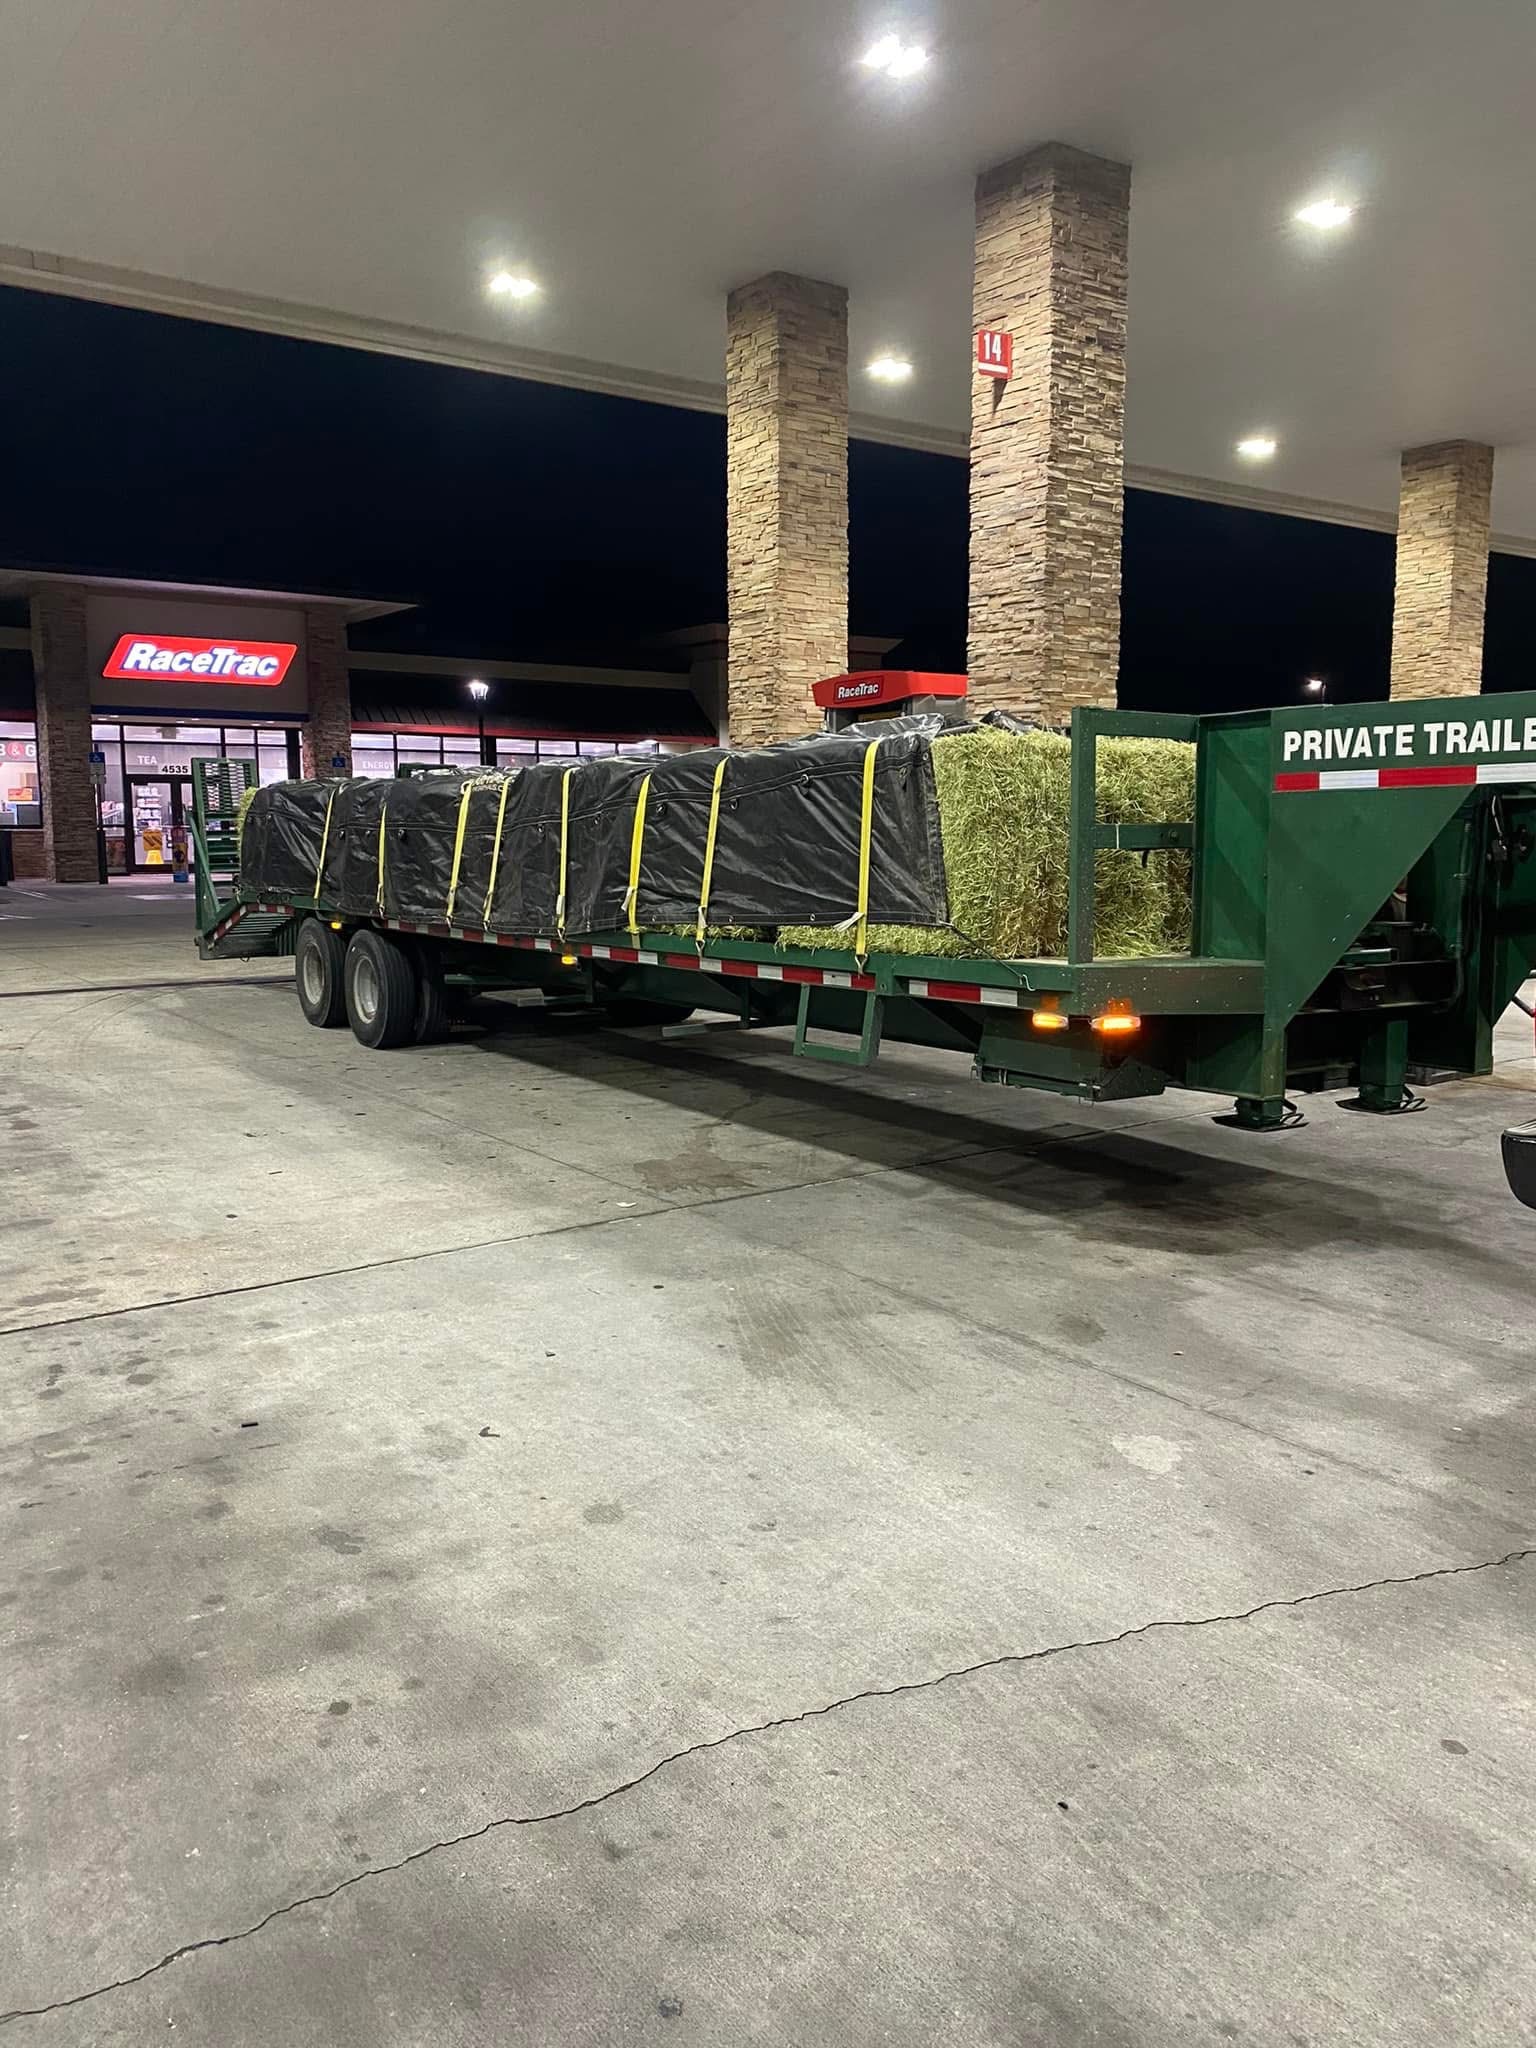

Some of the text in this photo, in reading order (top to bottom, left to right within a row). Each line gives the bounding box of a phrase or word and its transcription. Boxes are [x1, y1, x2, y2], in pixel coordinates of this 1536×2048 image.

[983, 332, 1002, 362] 14
[122, 641, 280, 678] RaceTrac
[837, 682, 880, 700] RaceTrac
[1283, 716, 1536, 762] PRIVATE TRAILE
[137, 755, 158, 765] TEA
[161, 765, 189, 774] 4535
